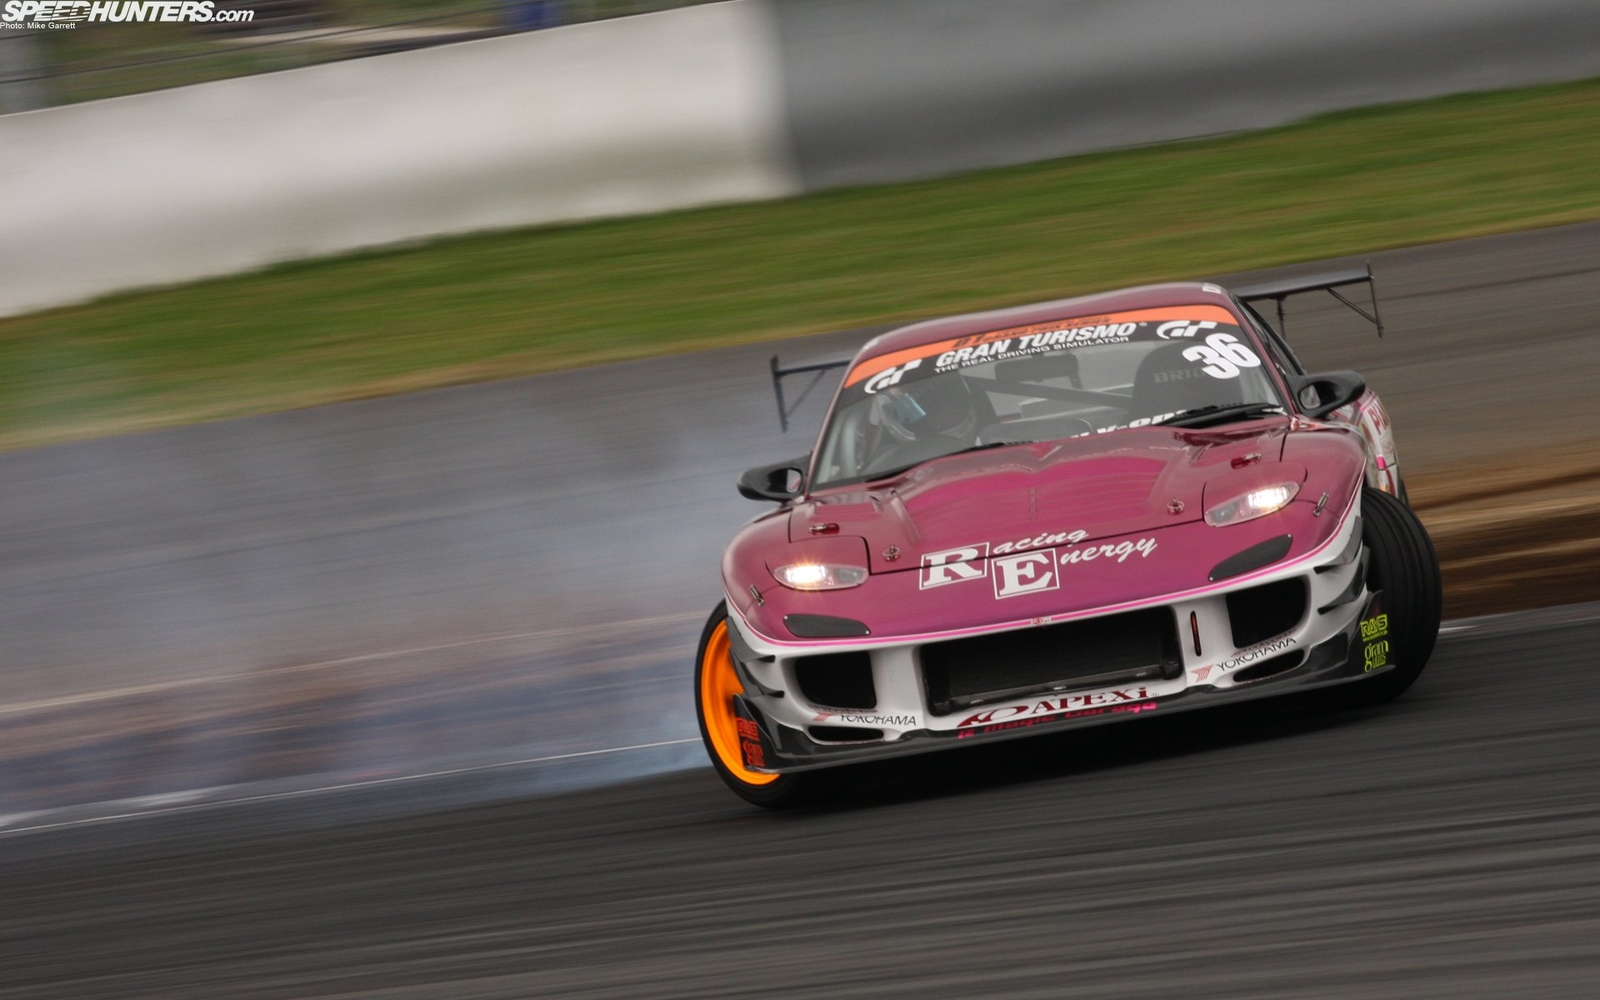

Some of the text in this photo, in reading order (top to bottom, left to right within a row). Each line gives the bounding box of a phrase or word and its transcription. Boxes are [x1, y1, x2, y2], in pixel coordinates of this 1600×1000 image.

[933, 336, 1129, 374] THE REAL DRIVING SIMULATOR
[936, 338, 1011, 368] GRAN
[1018, 322, 1137, 349] TURISMO
[1182, 333, 1261, 379] 36
[1216, 636, 1297, 672] YOKOHAMA
[841, 714, 917, 726] YOKOHAMA
